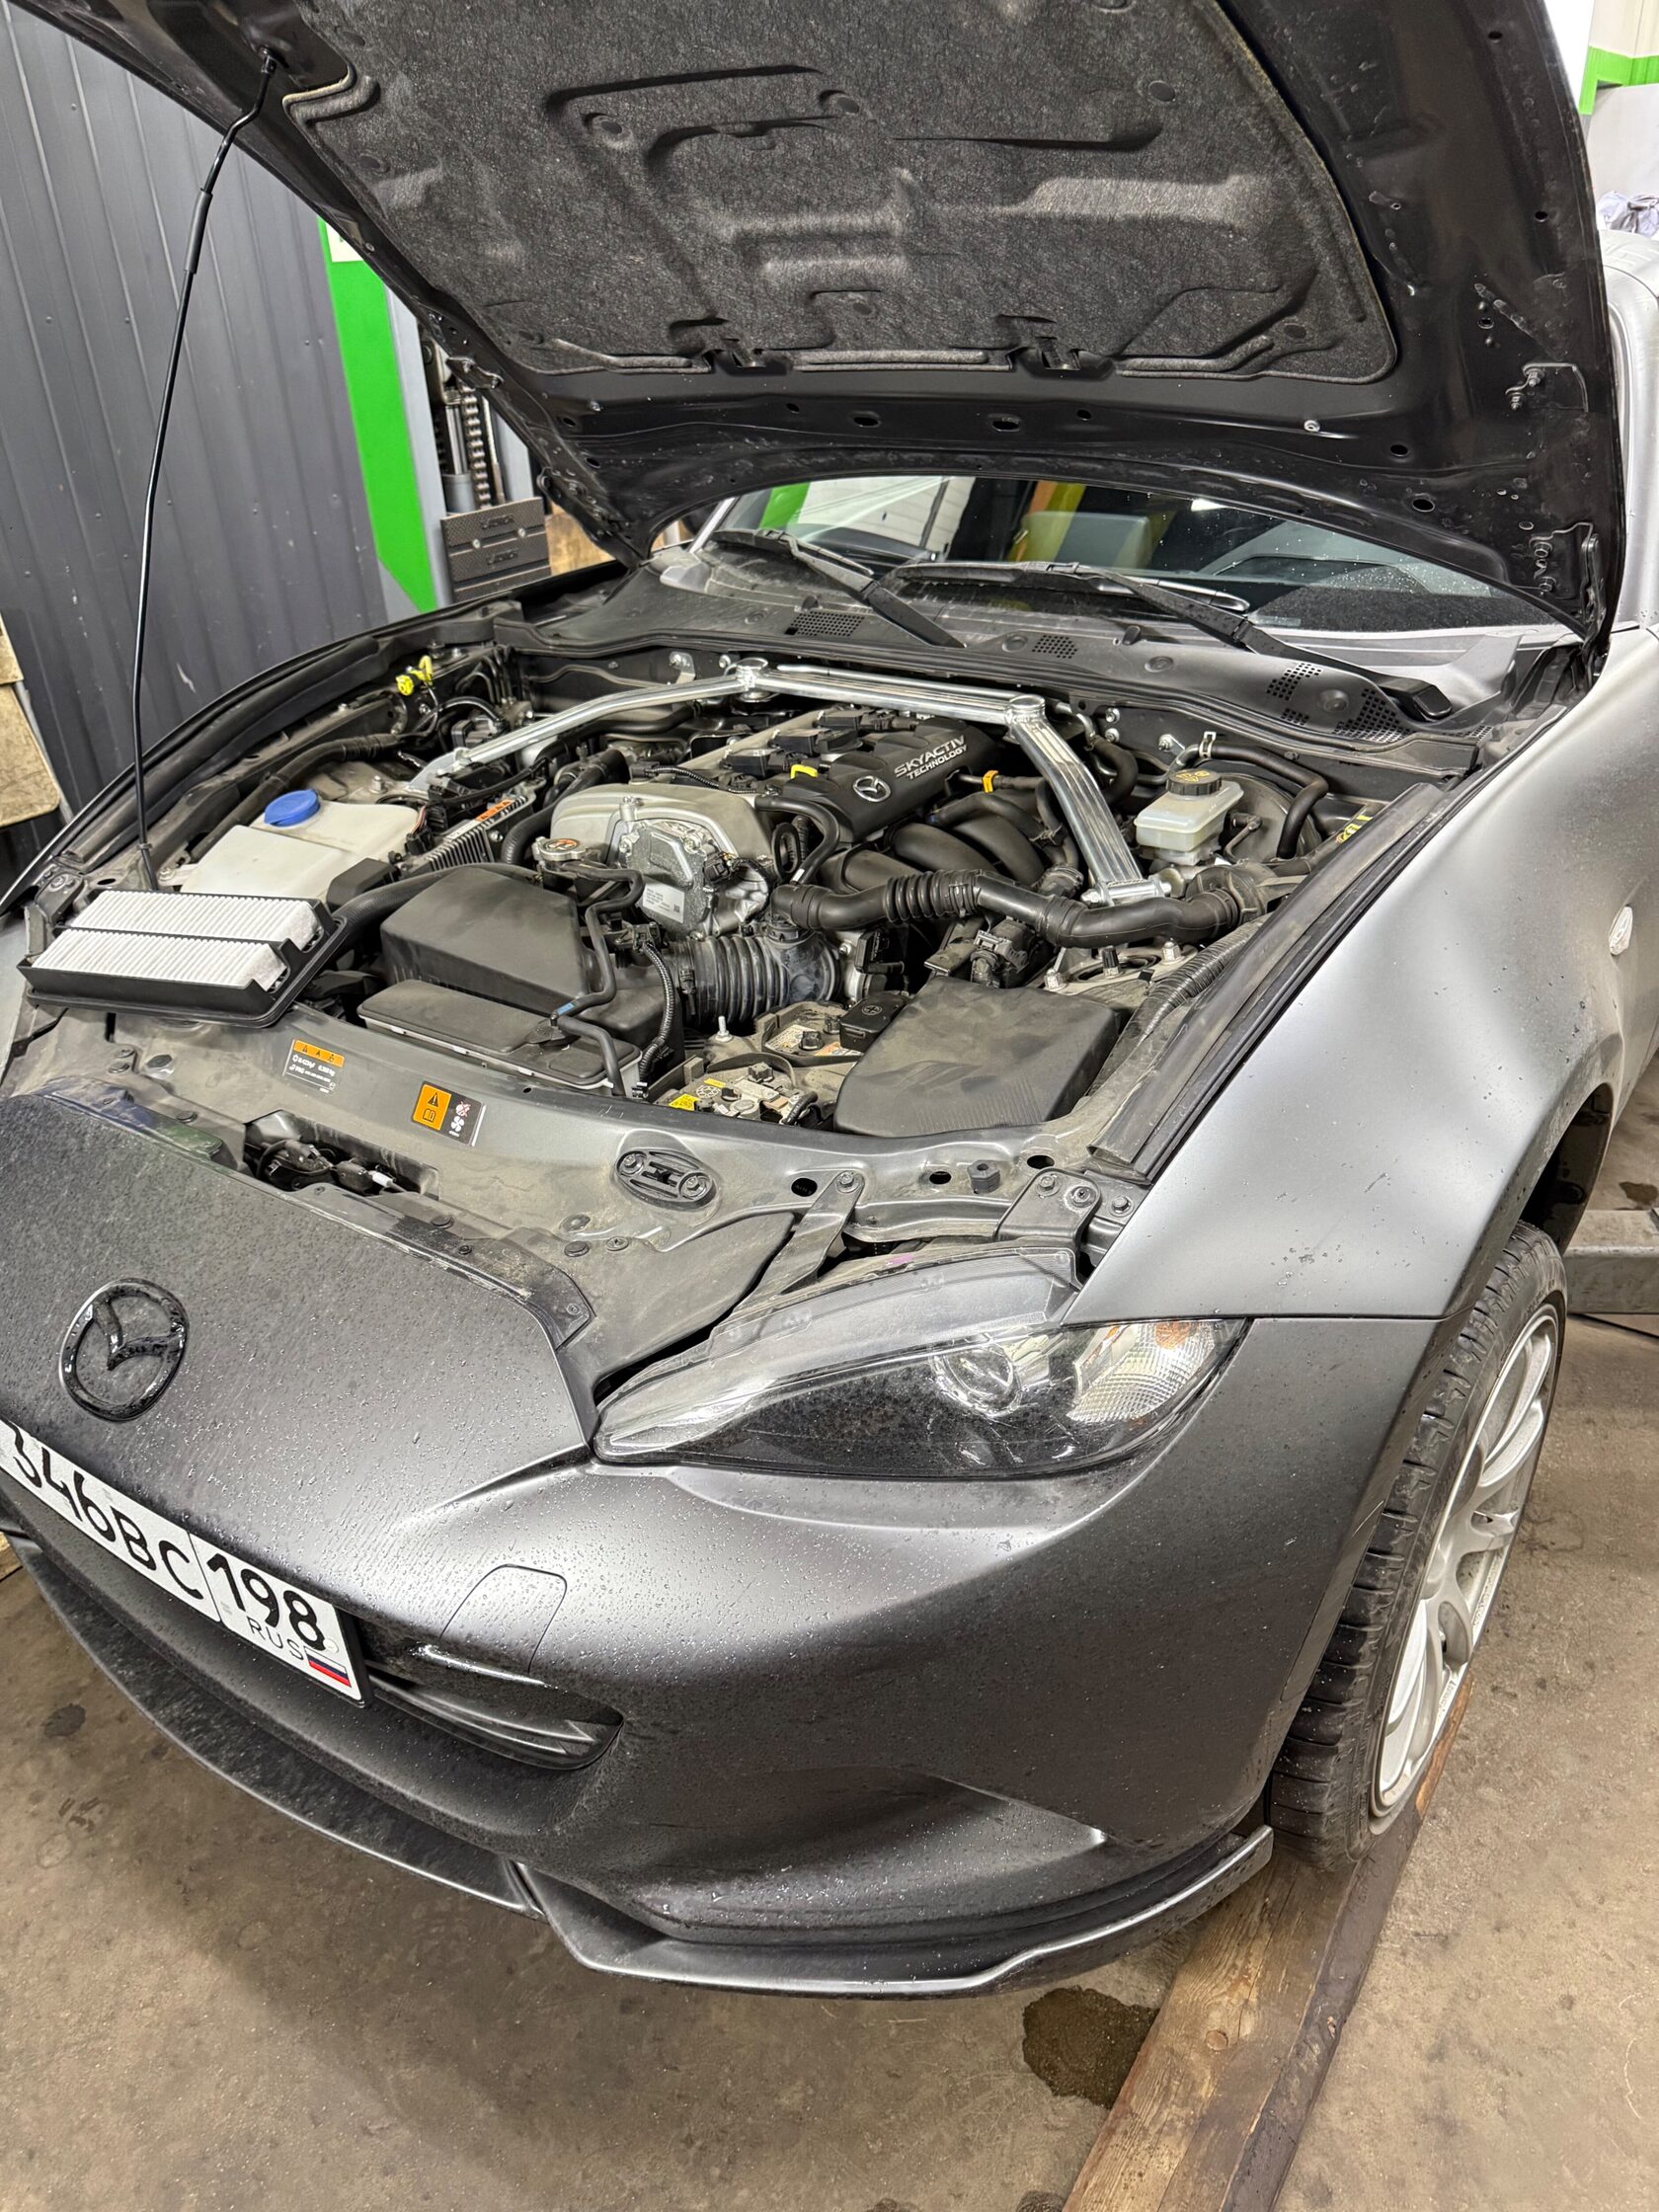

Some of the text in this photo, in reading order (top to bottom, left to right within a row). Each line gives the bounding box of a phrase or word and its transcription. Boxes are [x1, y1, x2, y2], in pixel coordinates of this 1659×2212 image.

[895, 736, 965, 777] SKYACTIV
[908, 746, 967, 778] TECHNOLOGY
[206, 1552, 327, 1651] 198
[246, 1617, 304, 1660] RUS
